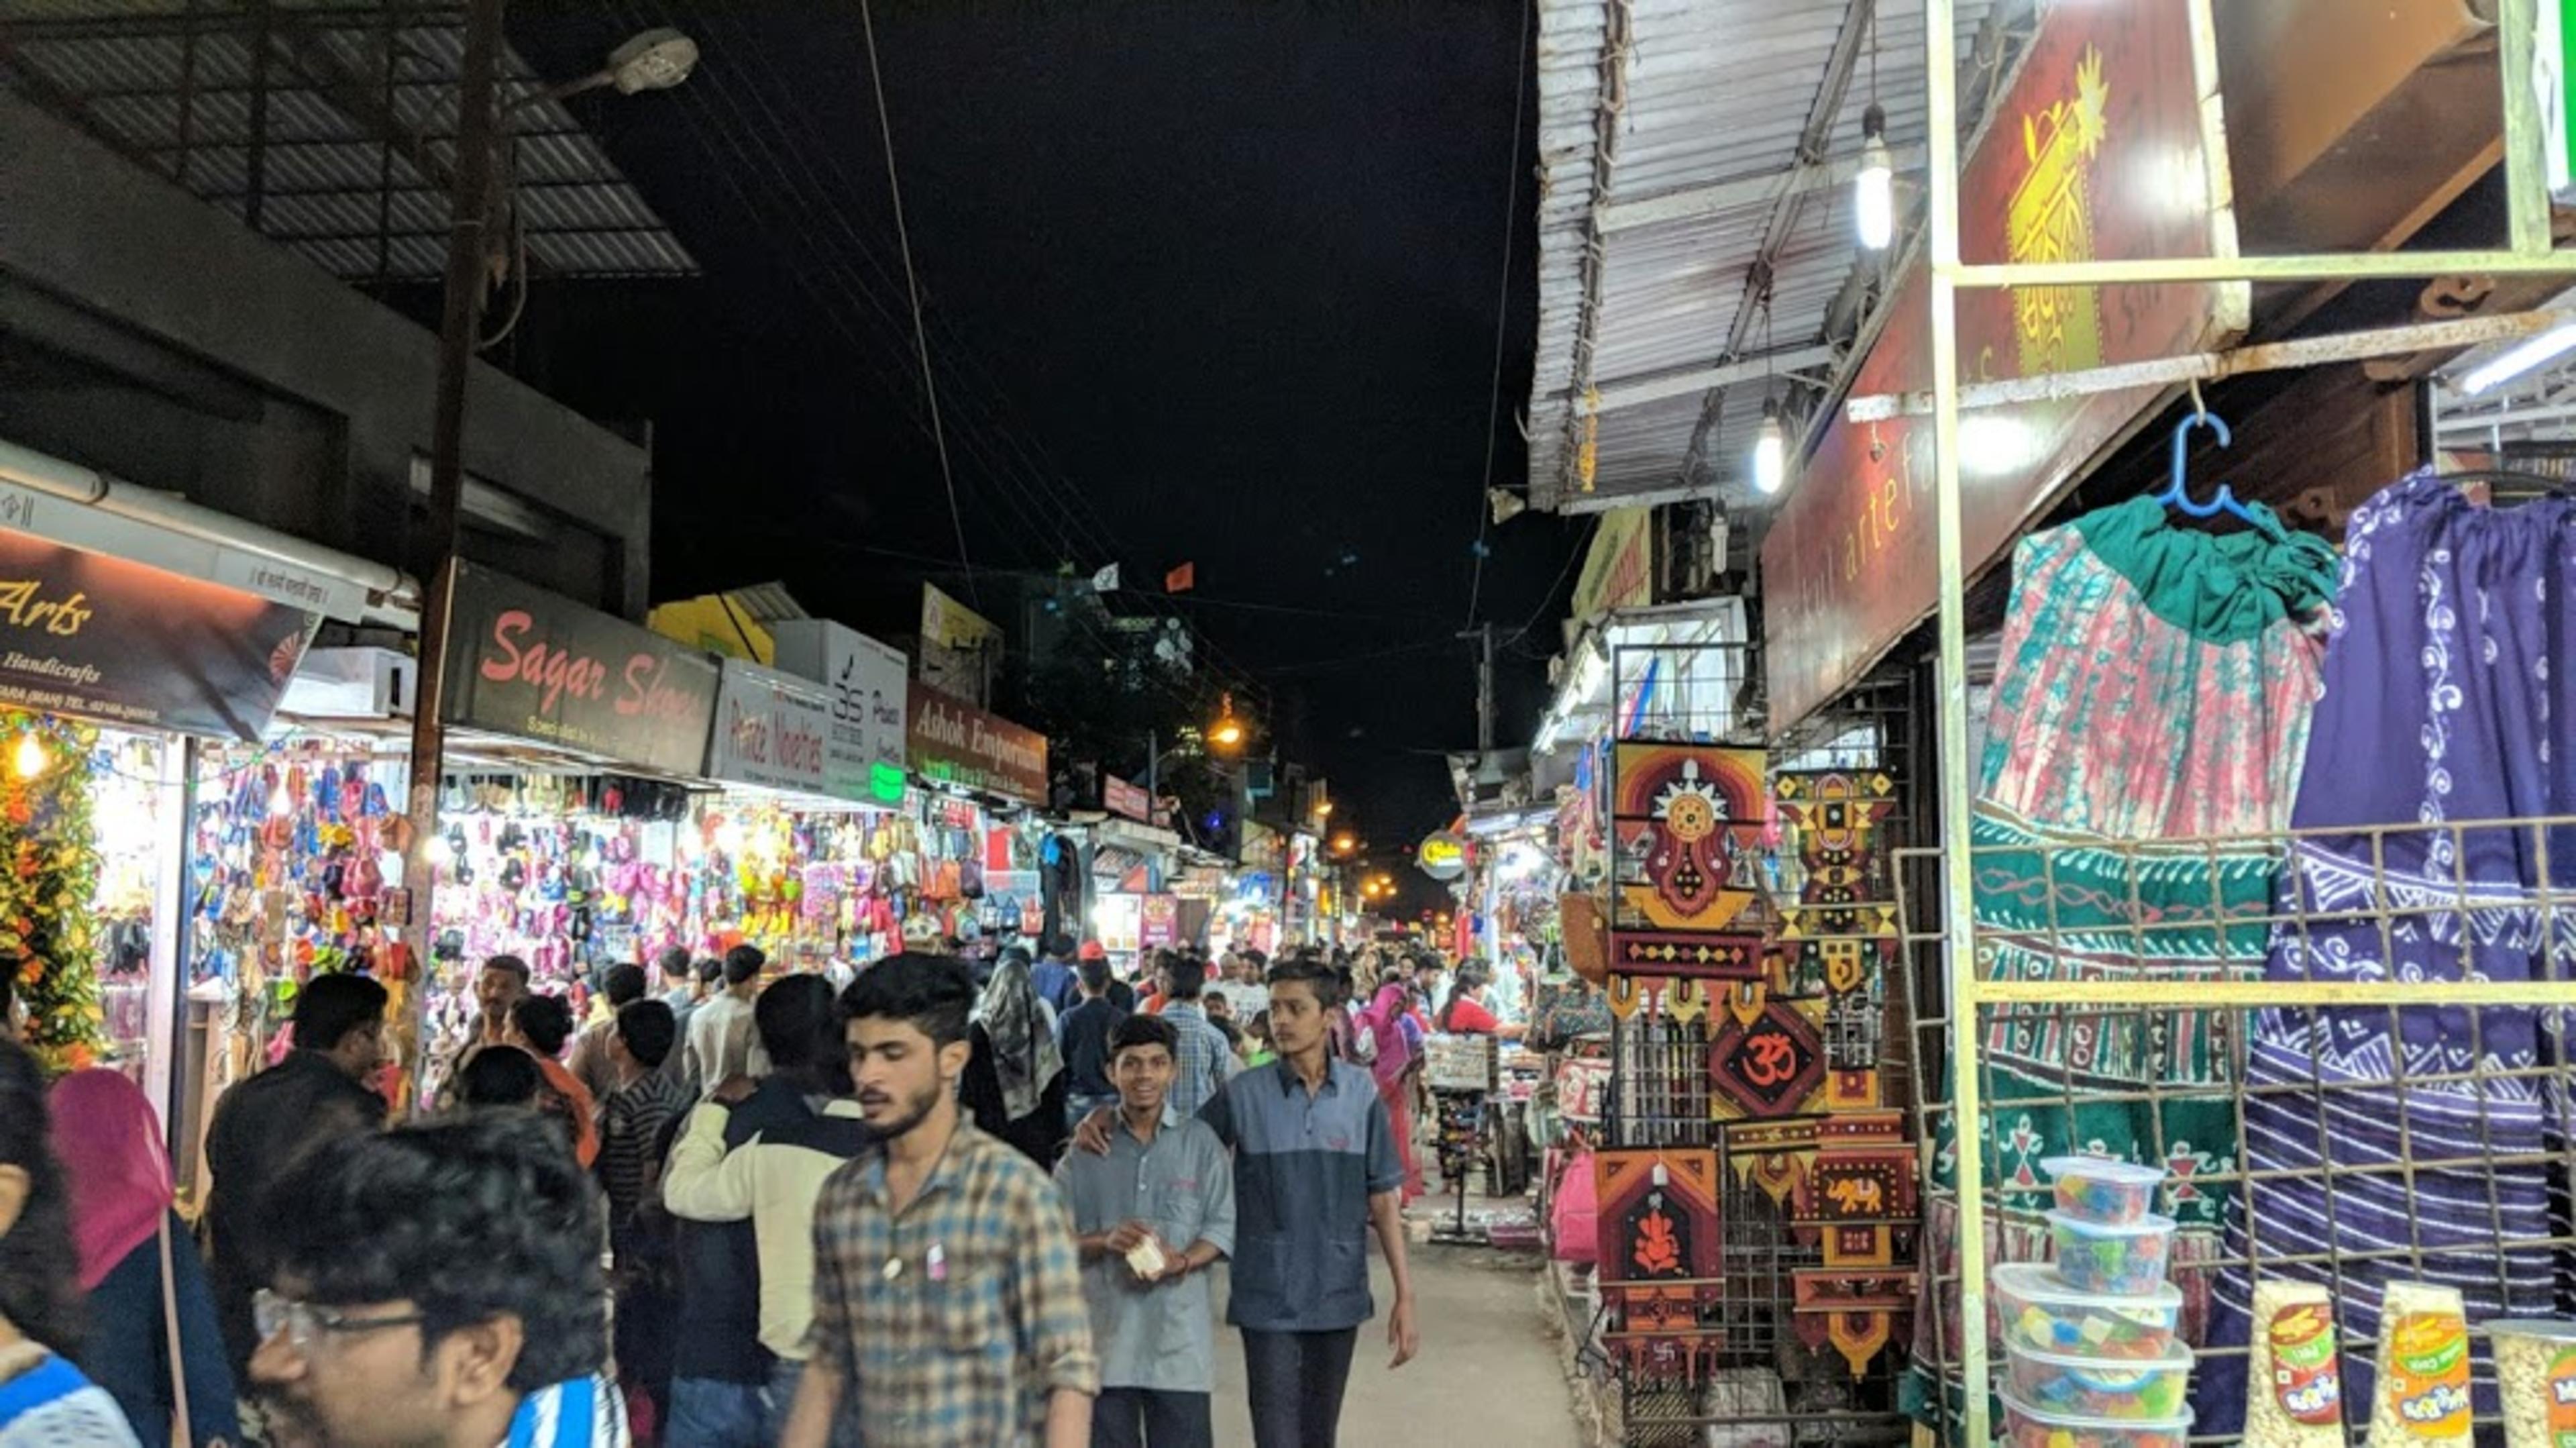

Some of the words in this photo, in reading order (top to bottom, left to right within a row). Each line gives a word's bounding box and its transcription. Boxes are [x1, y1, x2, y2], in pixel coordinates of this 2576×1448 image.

[0, 580, 93, 636] Arts
[2, 651, 102, 686] Handicrafts
[481, 611, 606, 714] Sagar
[915, 699, 966, 749] Ashok
[971, 717, 1044, 773] Emporium
